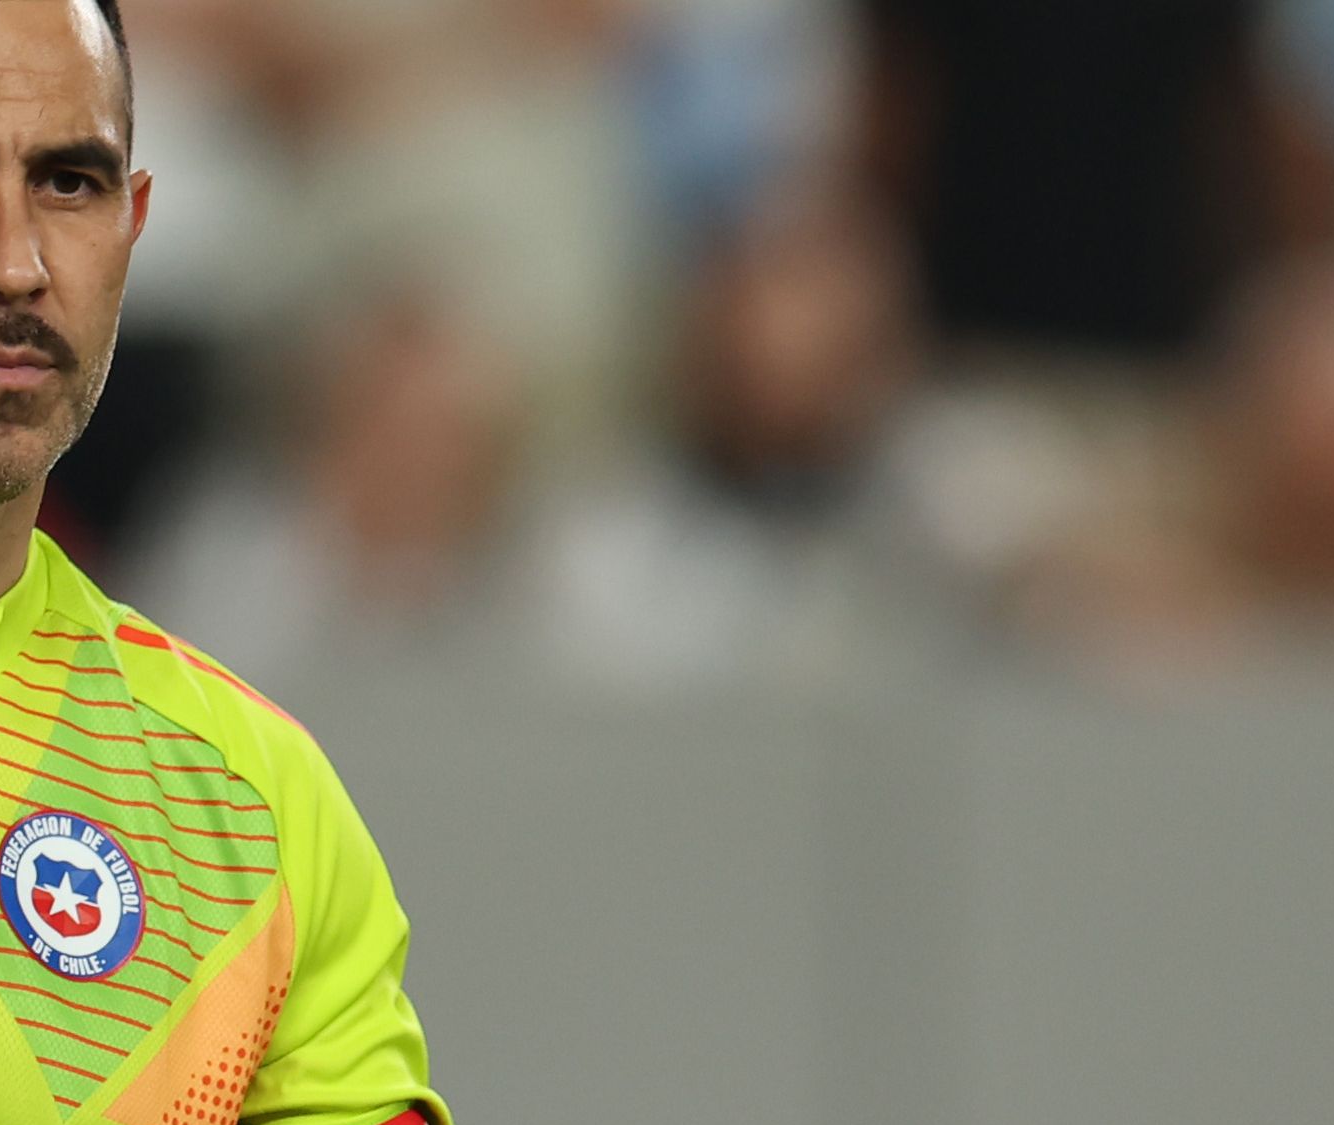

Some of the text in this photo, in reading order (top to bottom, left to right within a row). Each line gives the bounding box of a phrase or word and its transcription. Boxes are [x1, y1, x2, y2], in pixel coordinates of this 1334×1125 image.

[0, 816, 140, 915] FEDERACION DE FUTBOL
[31, 937, 102, 976] DE CHILE
